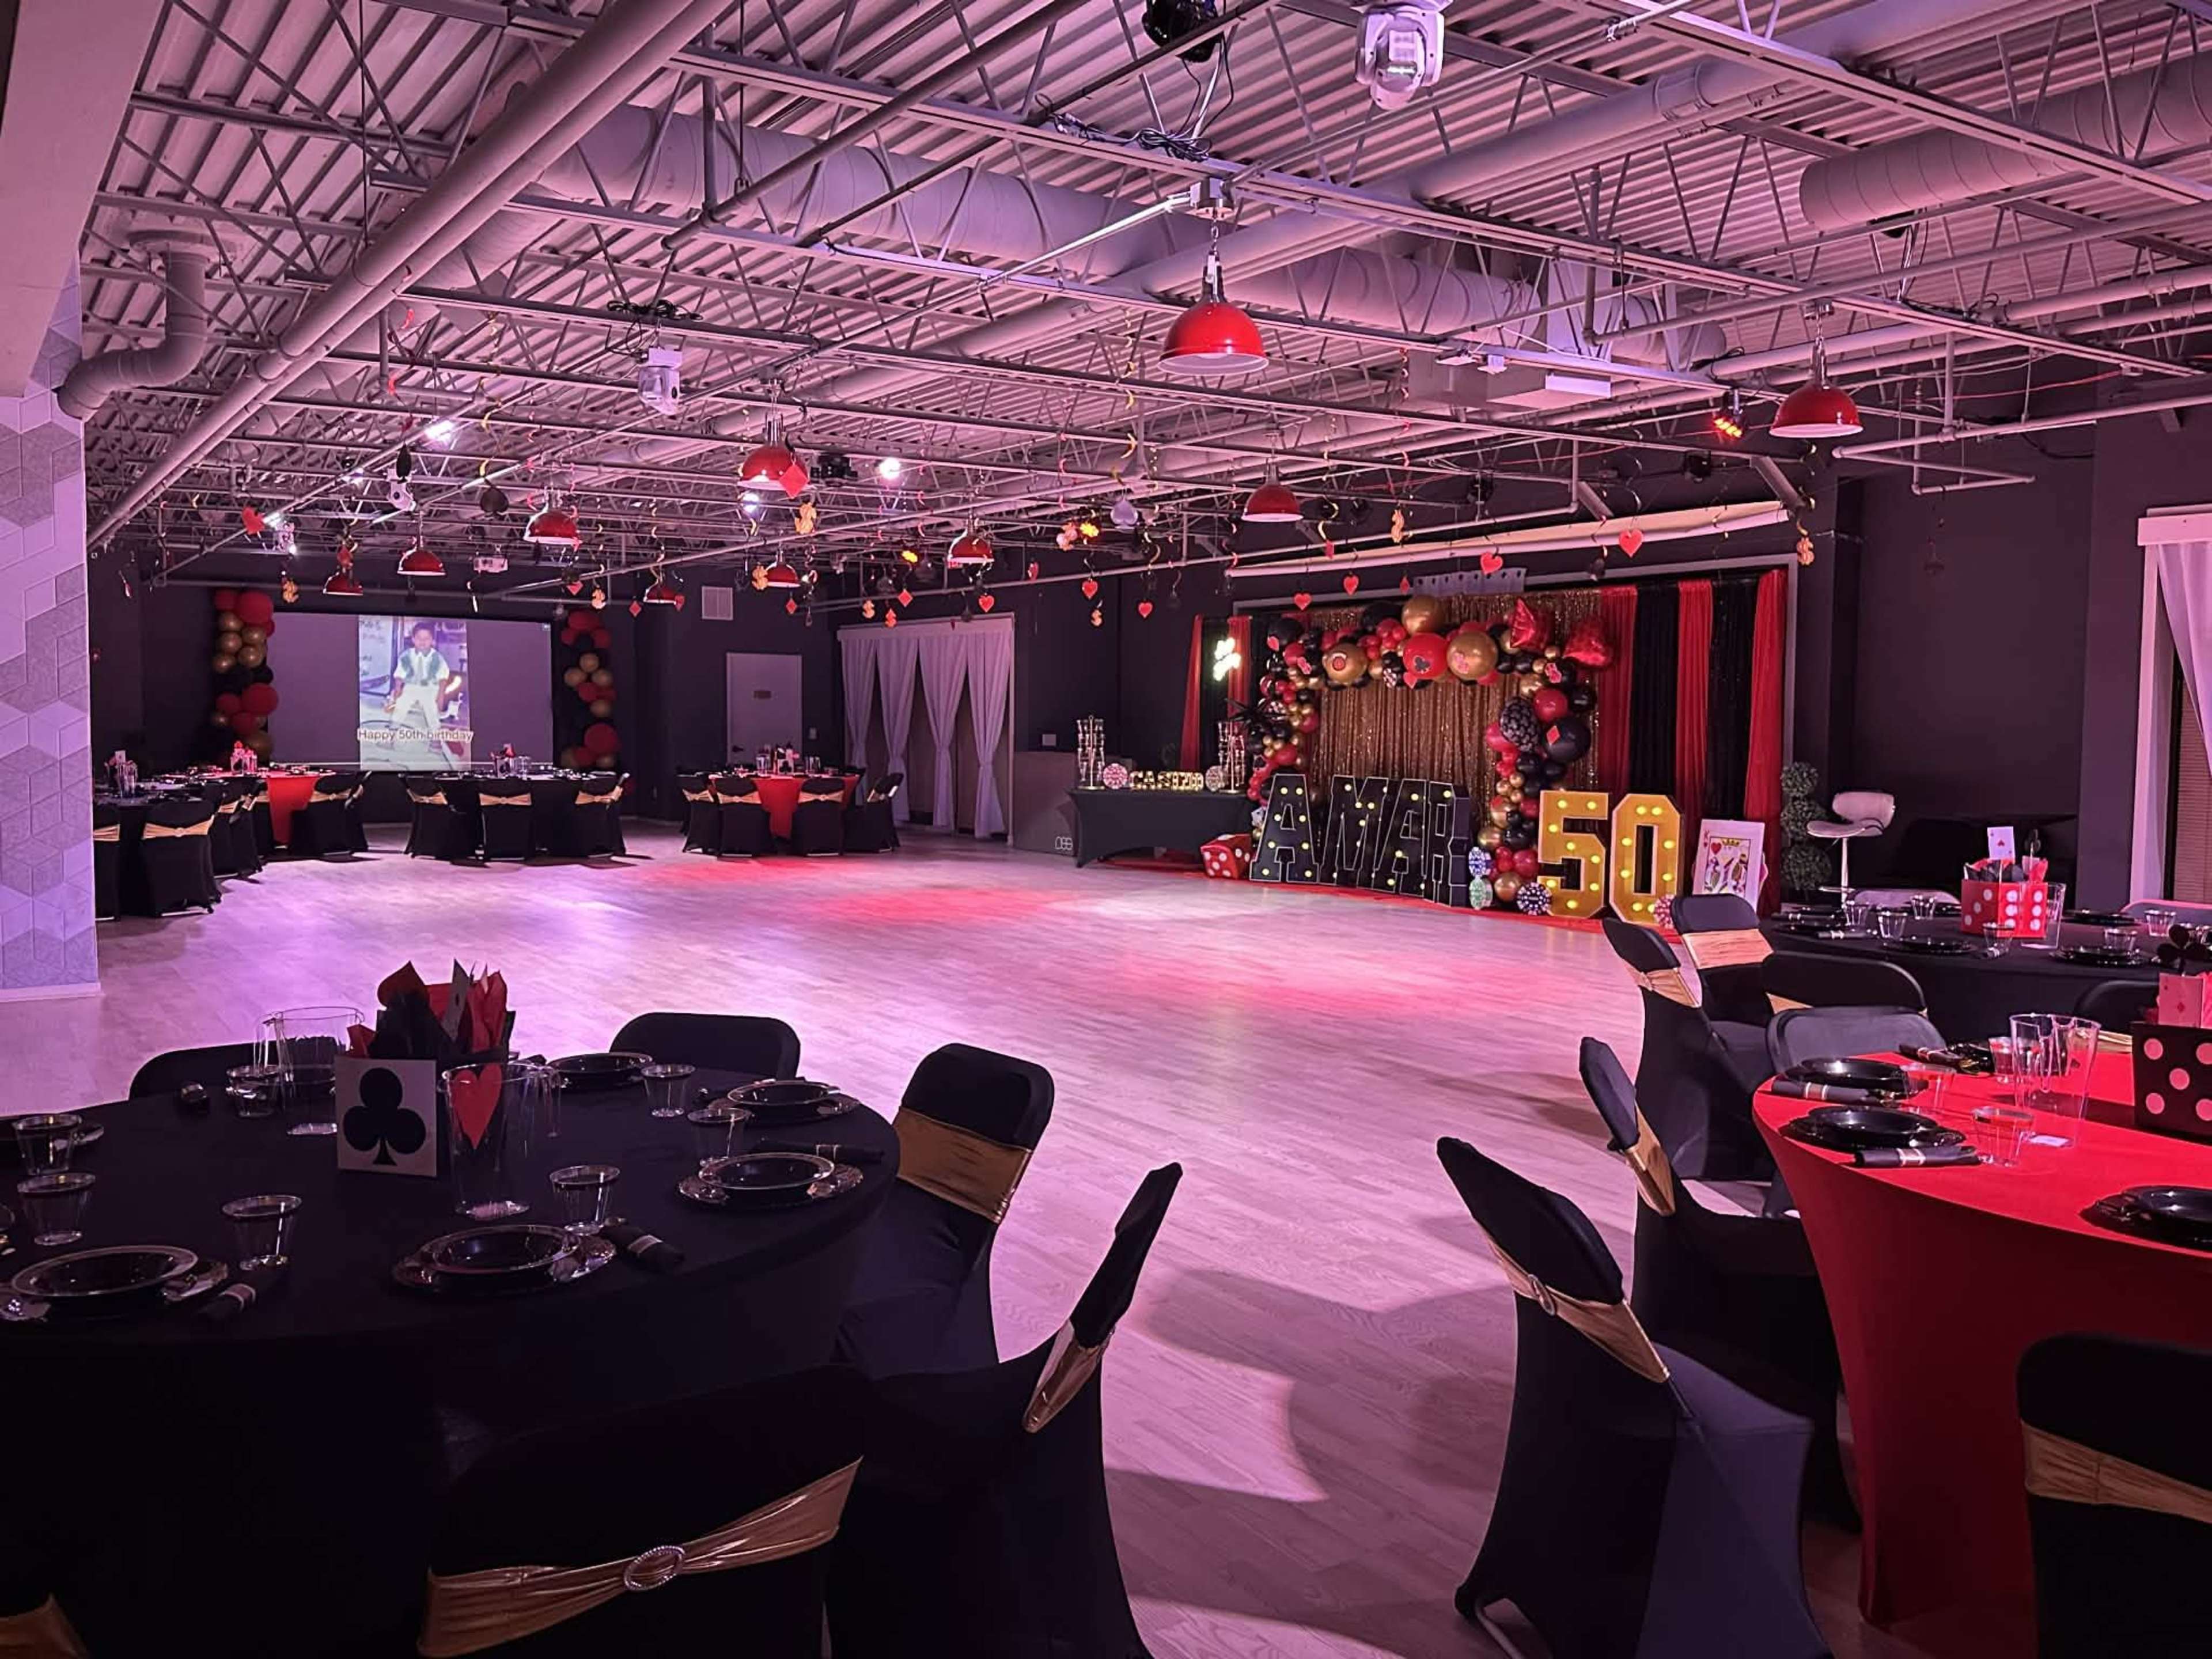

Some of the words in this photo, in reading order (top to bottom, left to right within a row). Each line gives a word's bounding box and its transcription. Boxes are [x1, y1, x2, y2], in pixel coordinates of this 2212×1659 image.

[358, 729, 396, 741] Happy
[399, 729, 423, 740] 50th
[427, 729, 473, 741] birthday
[1537, 790, 1681, 924] 50
